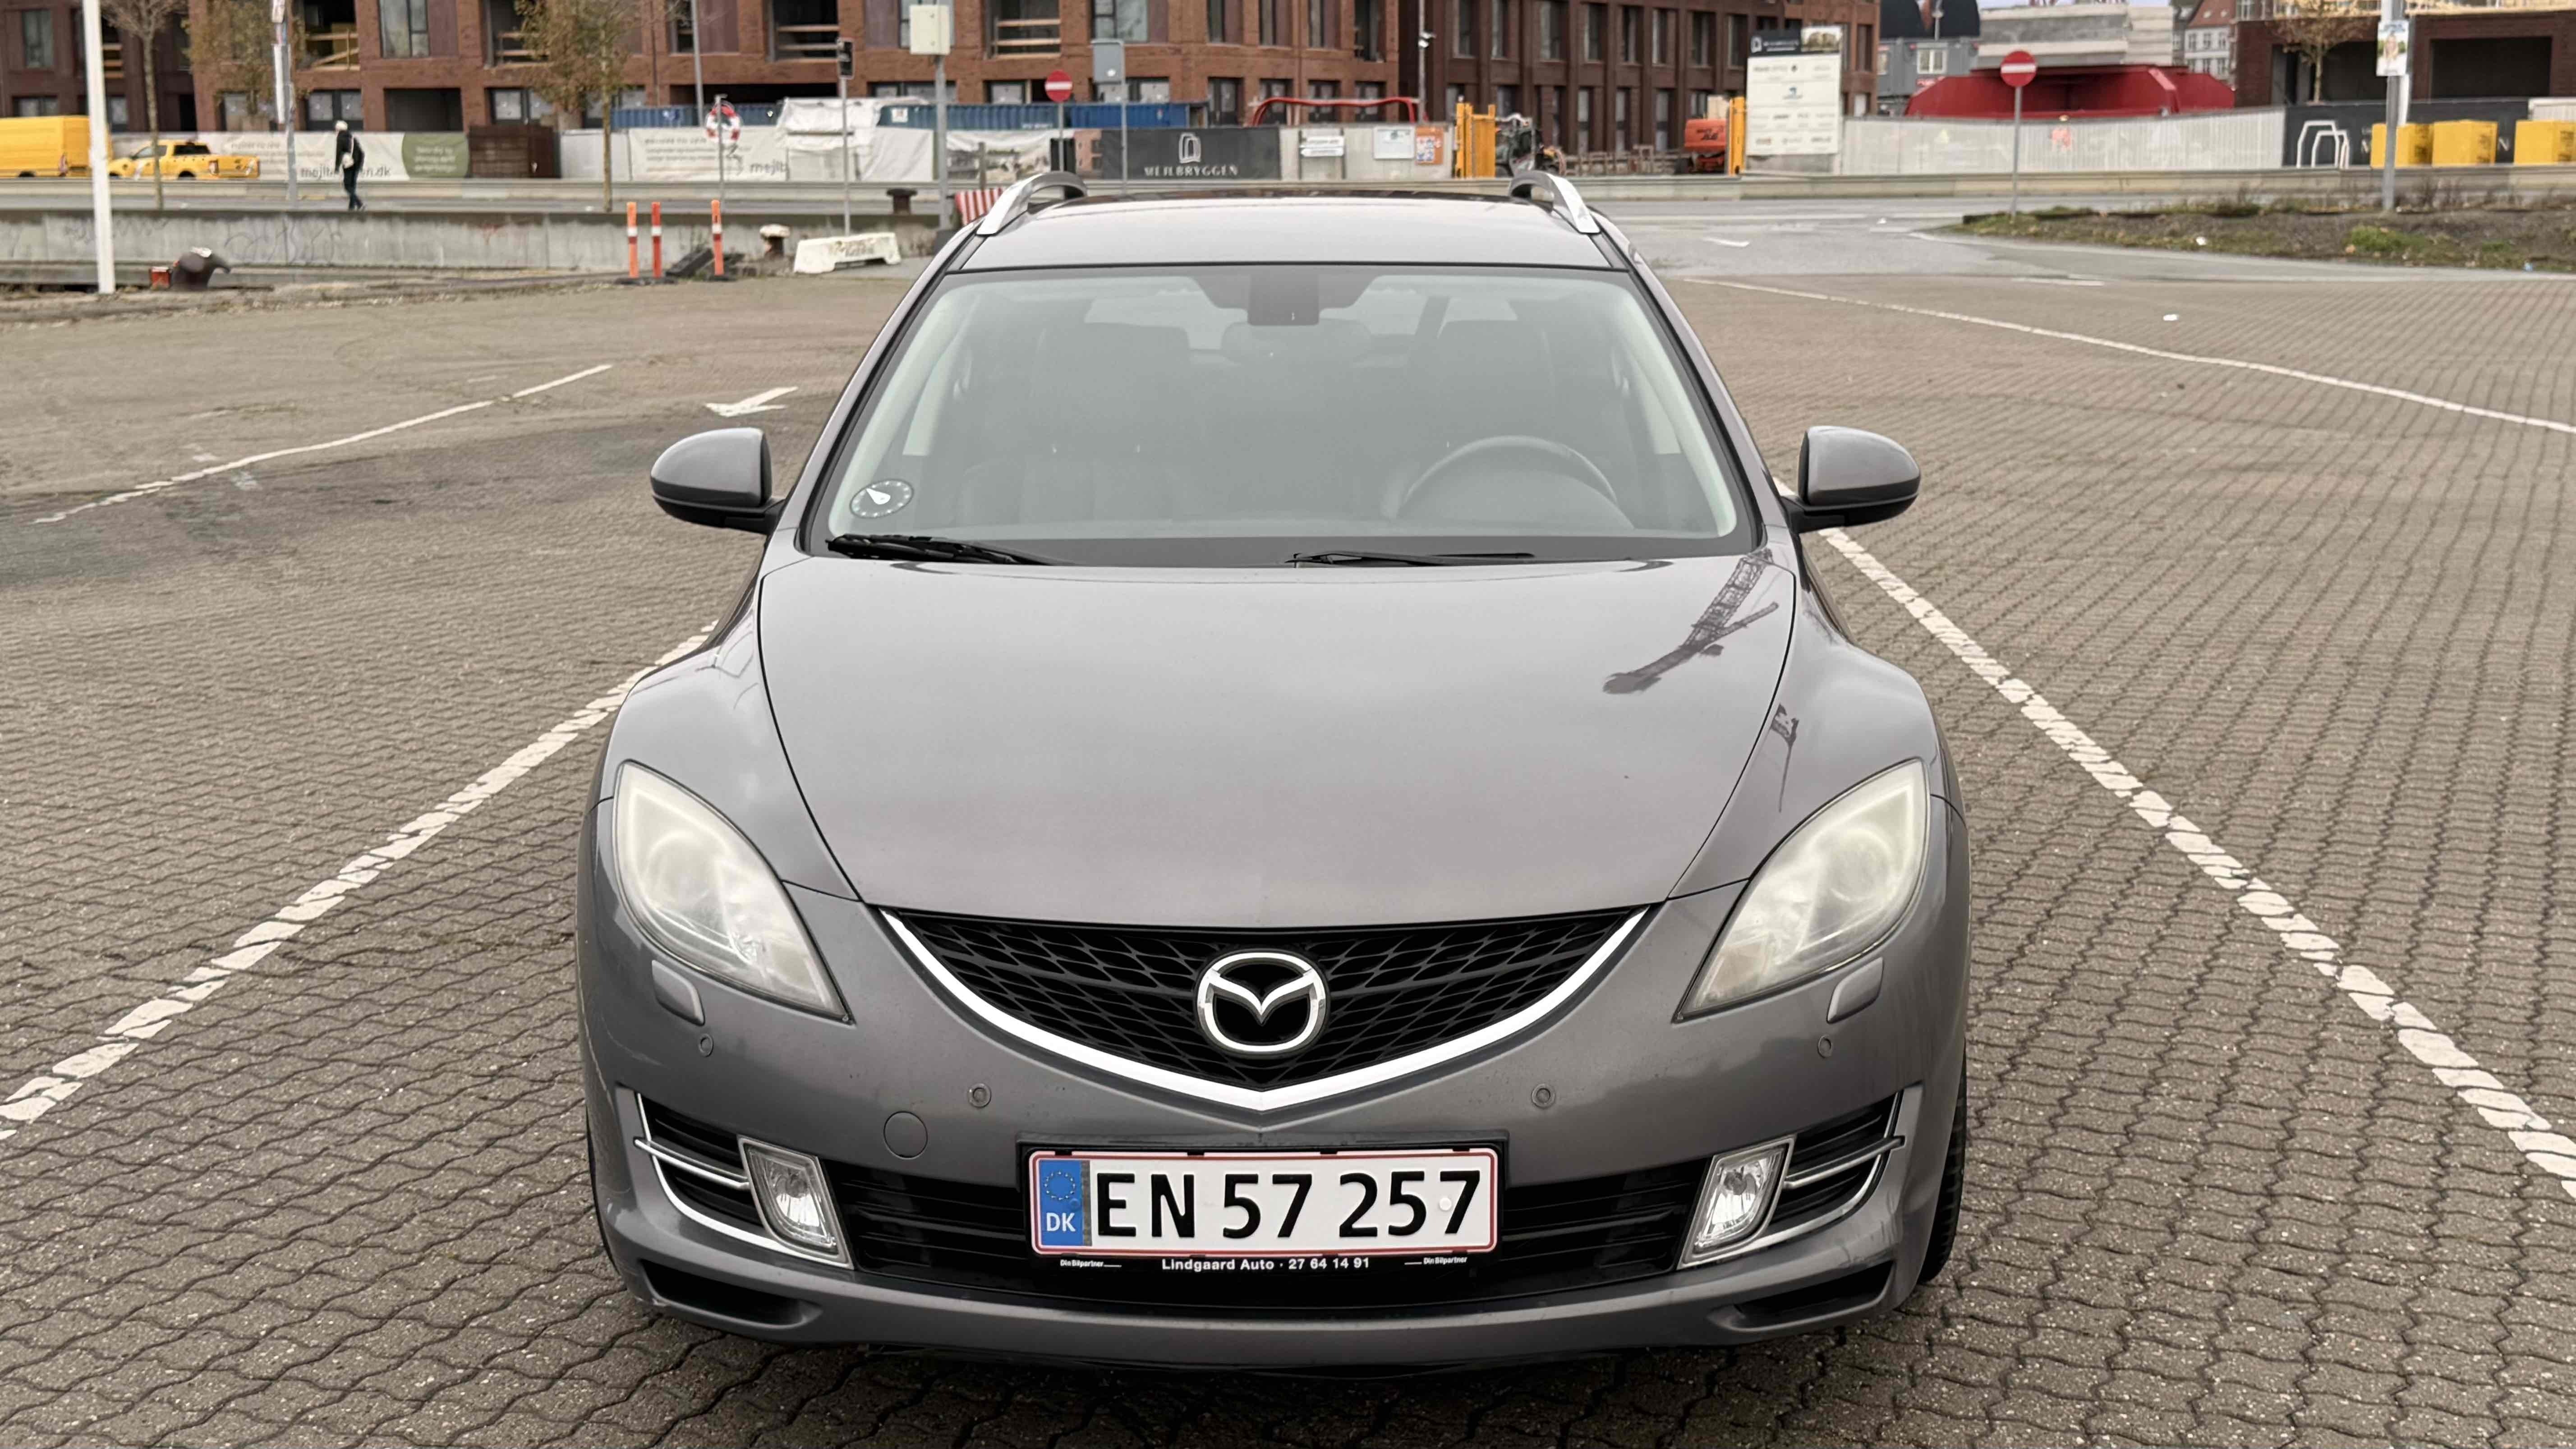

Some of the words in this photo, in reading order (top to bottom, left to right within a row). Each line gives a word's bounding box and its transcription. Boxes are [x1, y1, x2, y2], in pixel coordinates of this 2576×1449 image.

[1097, 1173, 1195, 1238] EN
[1223, 1173, 1312, 1239] 57
[1339, 1170, 1481, 1237] 257
[1046, 1212, 1076, 1232] DK
[1072, 1259, 1104, 1269] Bilpartner
[1161, 1259, 1235, 1272] Lindgaard
[1240, 1259, 1275, 1270] Auto
[1288, 1258, 1306, 1270] 27
[1310, 1257, 1328, 1270] 64
[1332, 1257, 1349, 1269] 14
[1353, 1257, 1369, 1269] 91
[1435, 1256, 1468, 1265] Bilpartner
